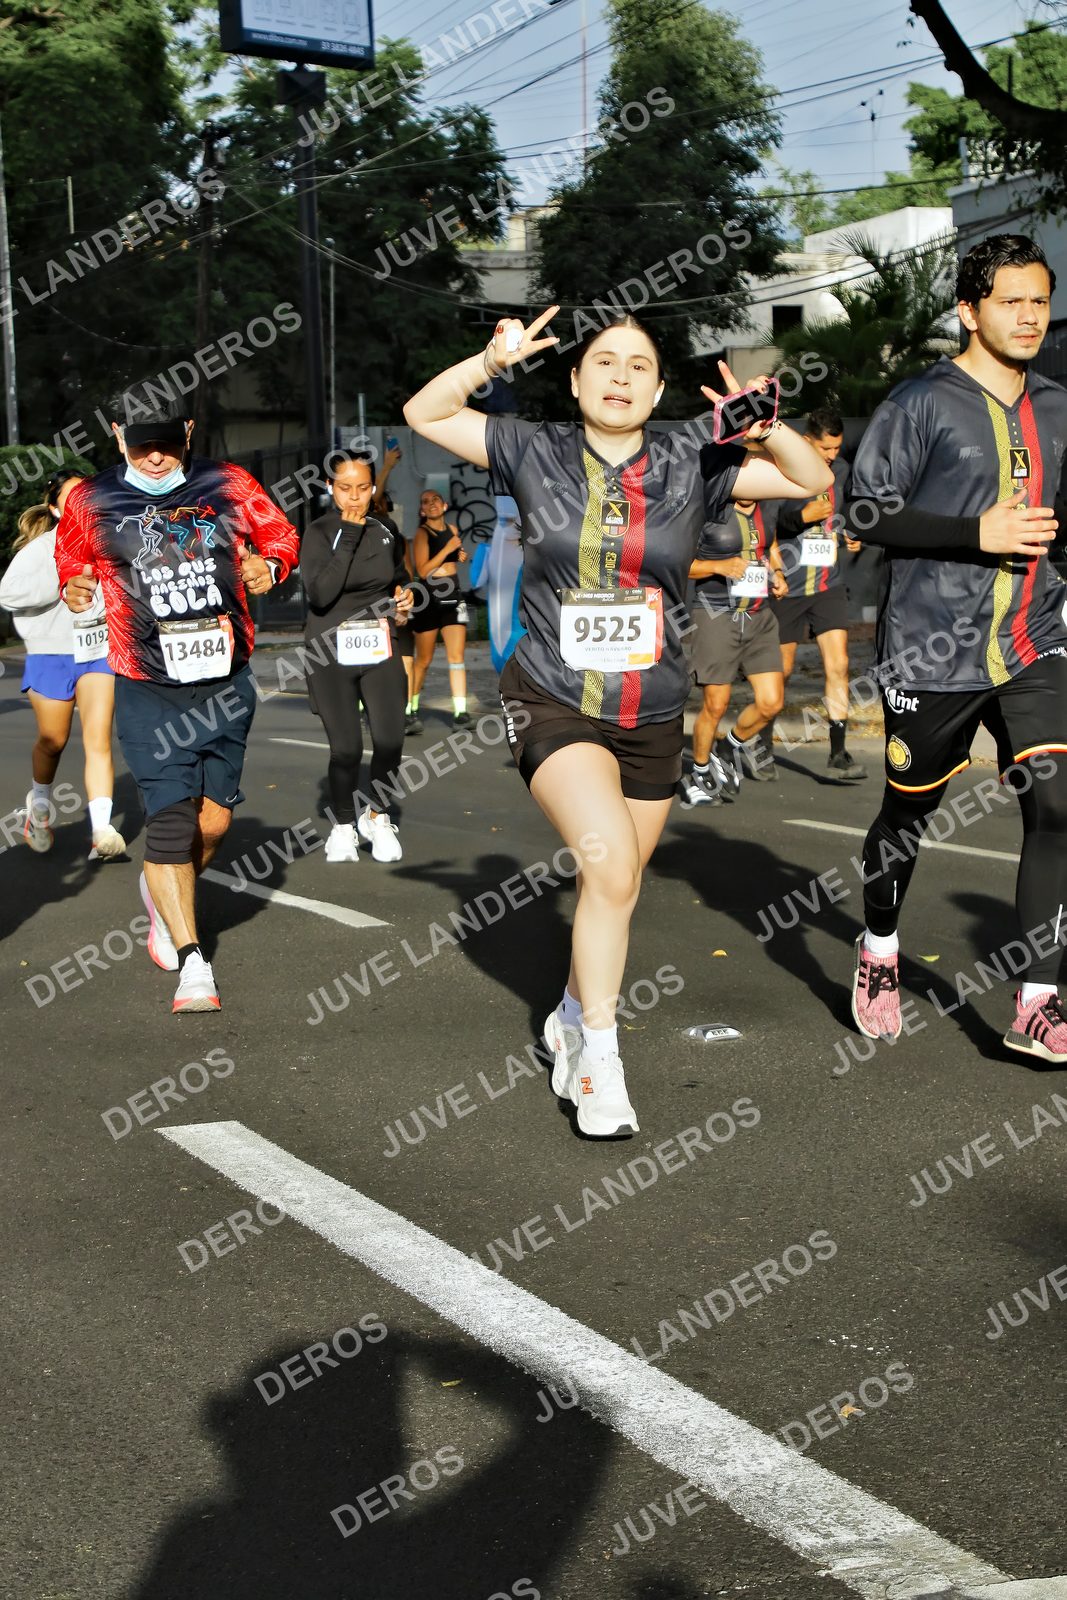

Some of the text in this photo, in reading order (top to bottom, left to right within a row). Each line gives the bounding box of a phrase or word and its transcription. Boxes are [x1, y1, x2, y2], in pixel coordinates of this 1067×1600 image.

[808, 543, 831, 554] 5504
[141, 557, 217, 584] LOS QUE
[150, 574, 216, 596] HACEMOS
[150, 584, 223, 617] BOLA
[574, 616, 641, 642] 9525
[165, 636, 227, 662] 13484
[346, 636, 378, 649] 8063
